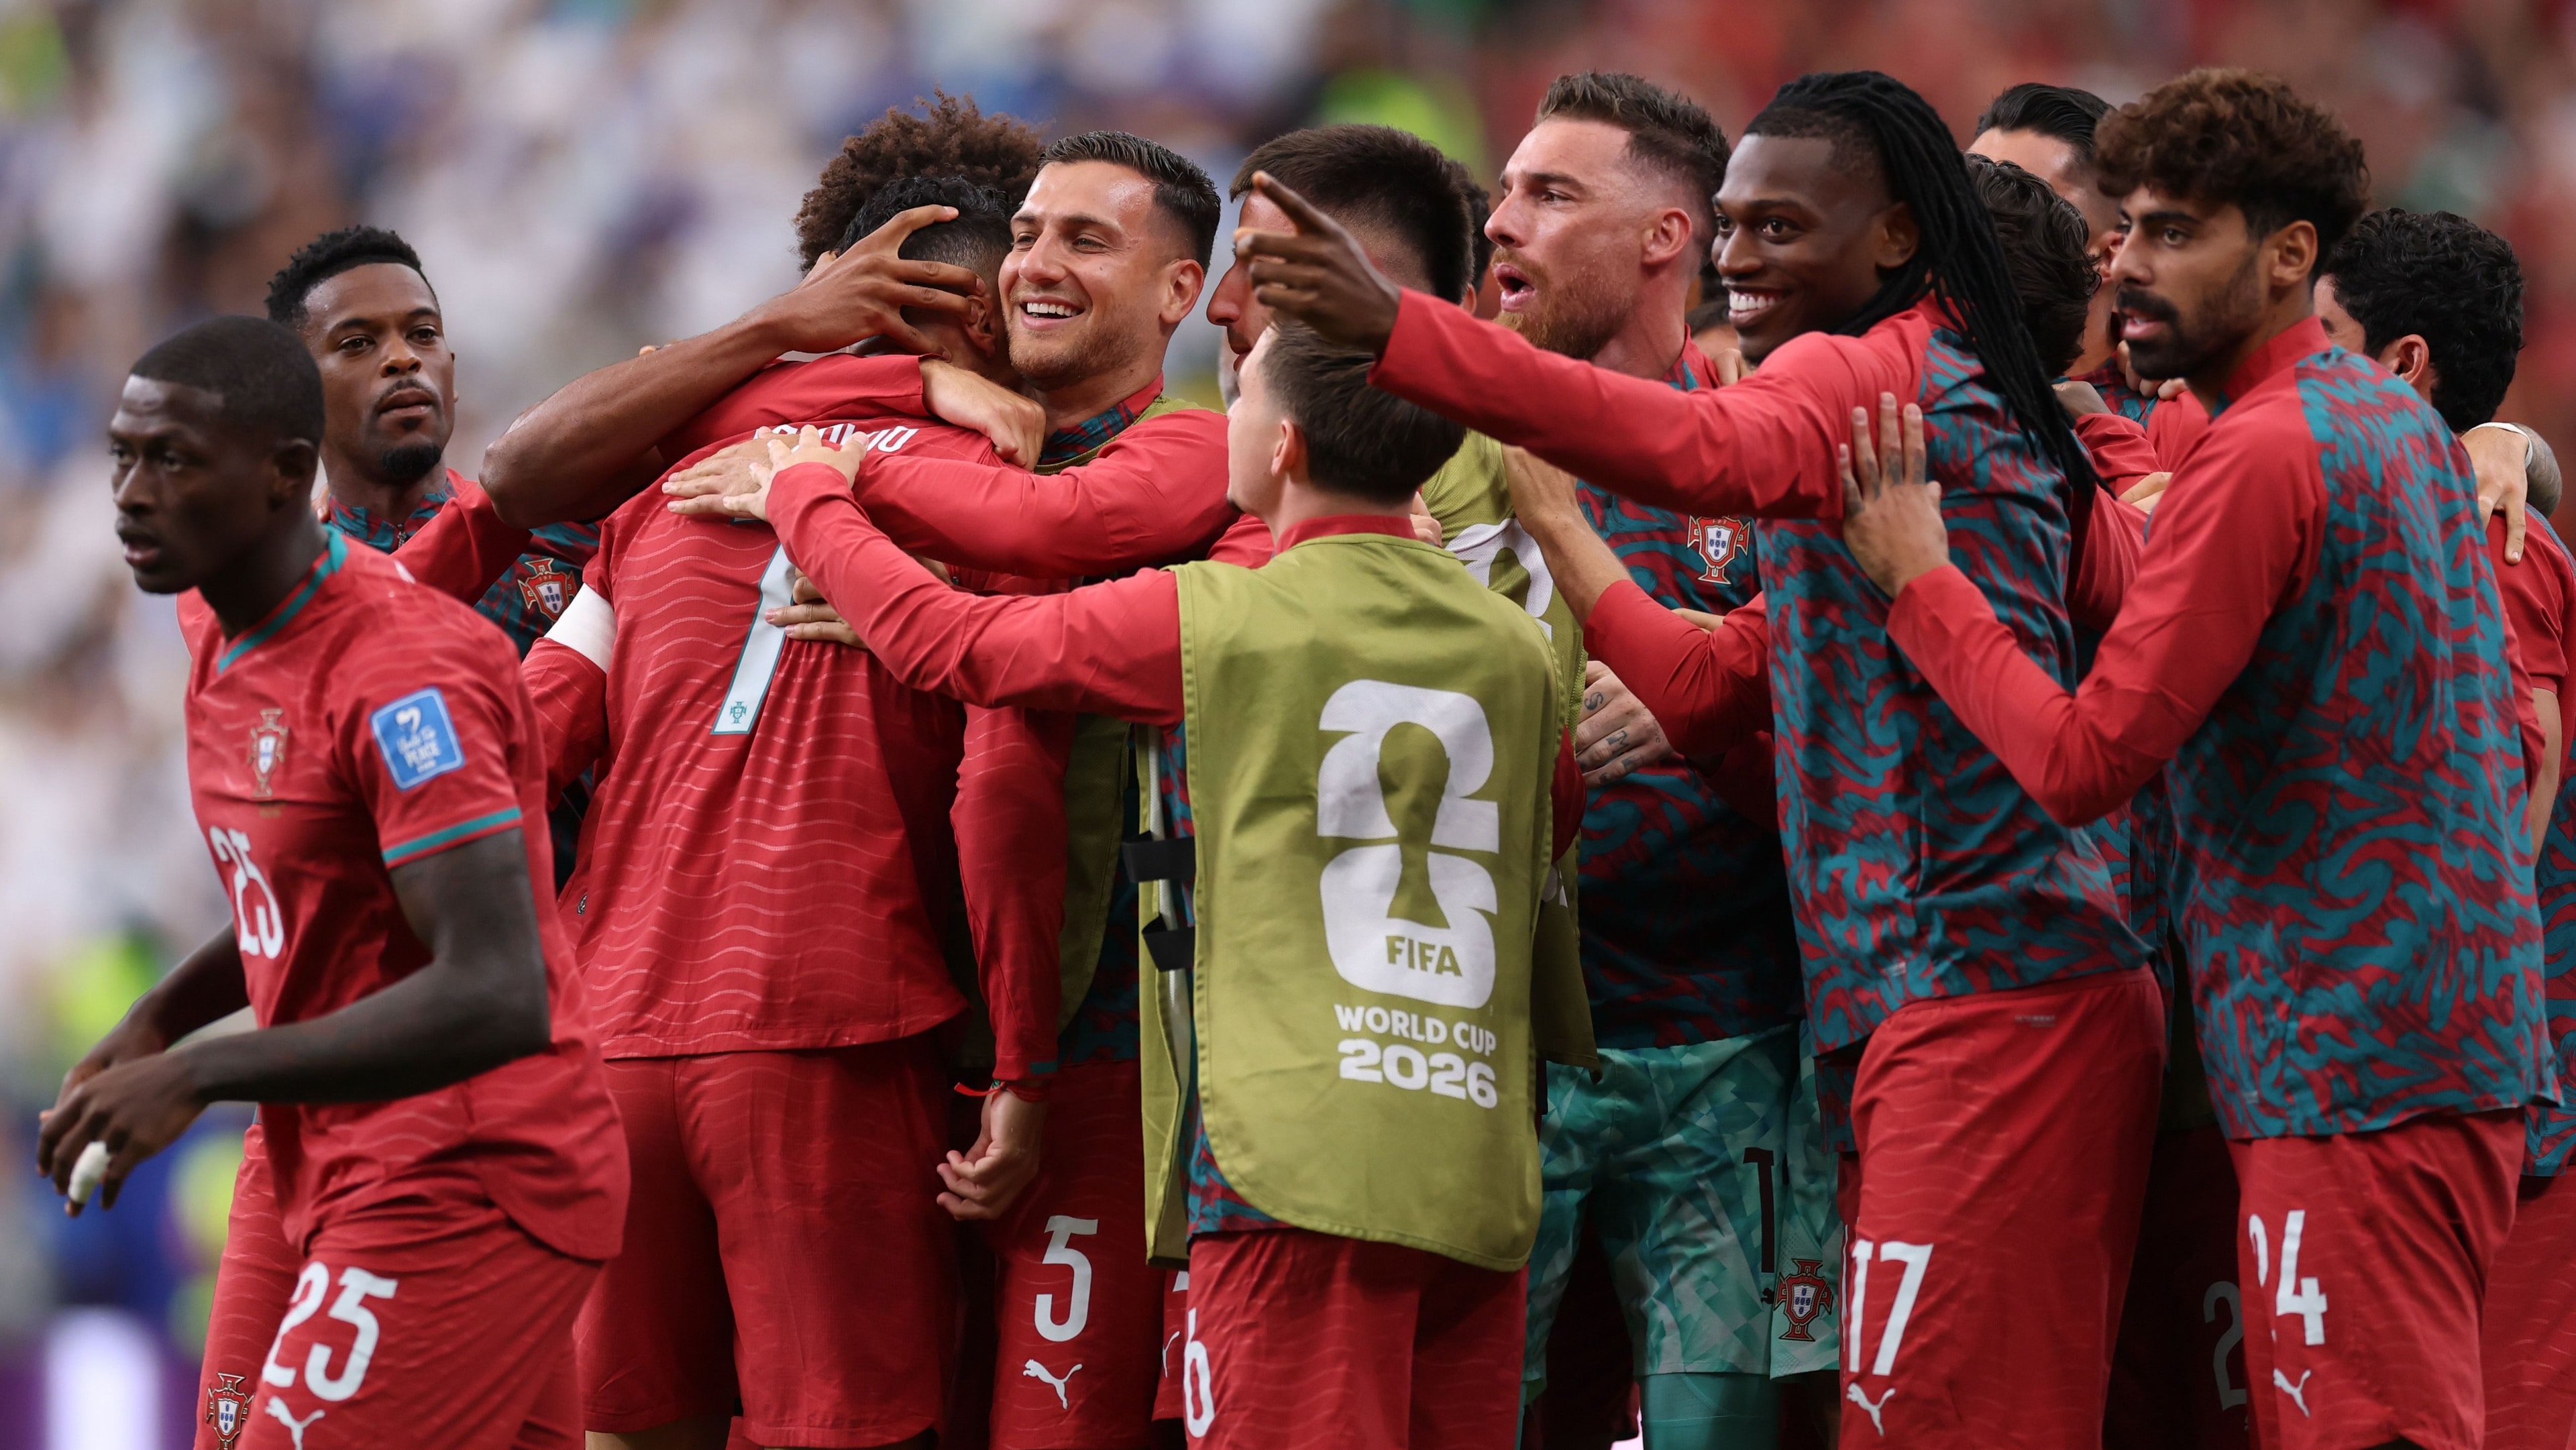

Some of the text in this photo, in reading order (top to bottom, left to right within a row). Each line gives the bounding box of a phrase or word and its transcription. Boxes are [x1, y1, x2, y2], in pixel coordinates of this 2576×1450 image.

[209, 825, 284, 960] 25
[1385, 935, 1463, 977] FIFA
[1334, 1003, 1497, 1057] WORLD CUP
[1337, 1038, 1498, 1109] 2026
[262, 1260, 399, 1402] 25
[1034, 1215, 1099, 1342] 5
[1849, 1238, 1935, 1376] 17
